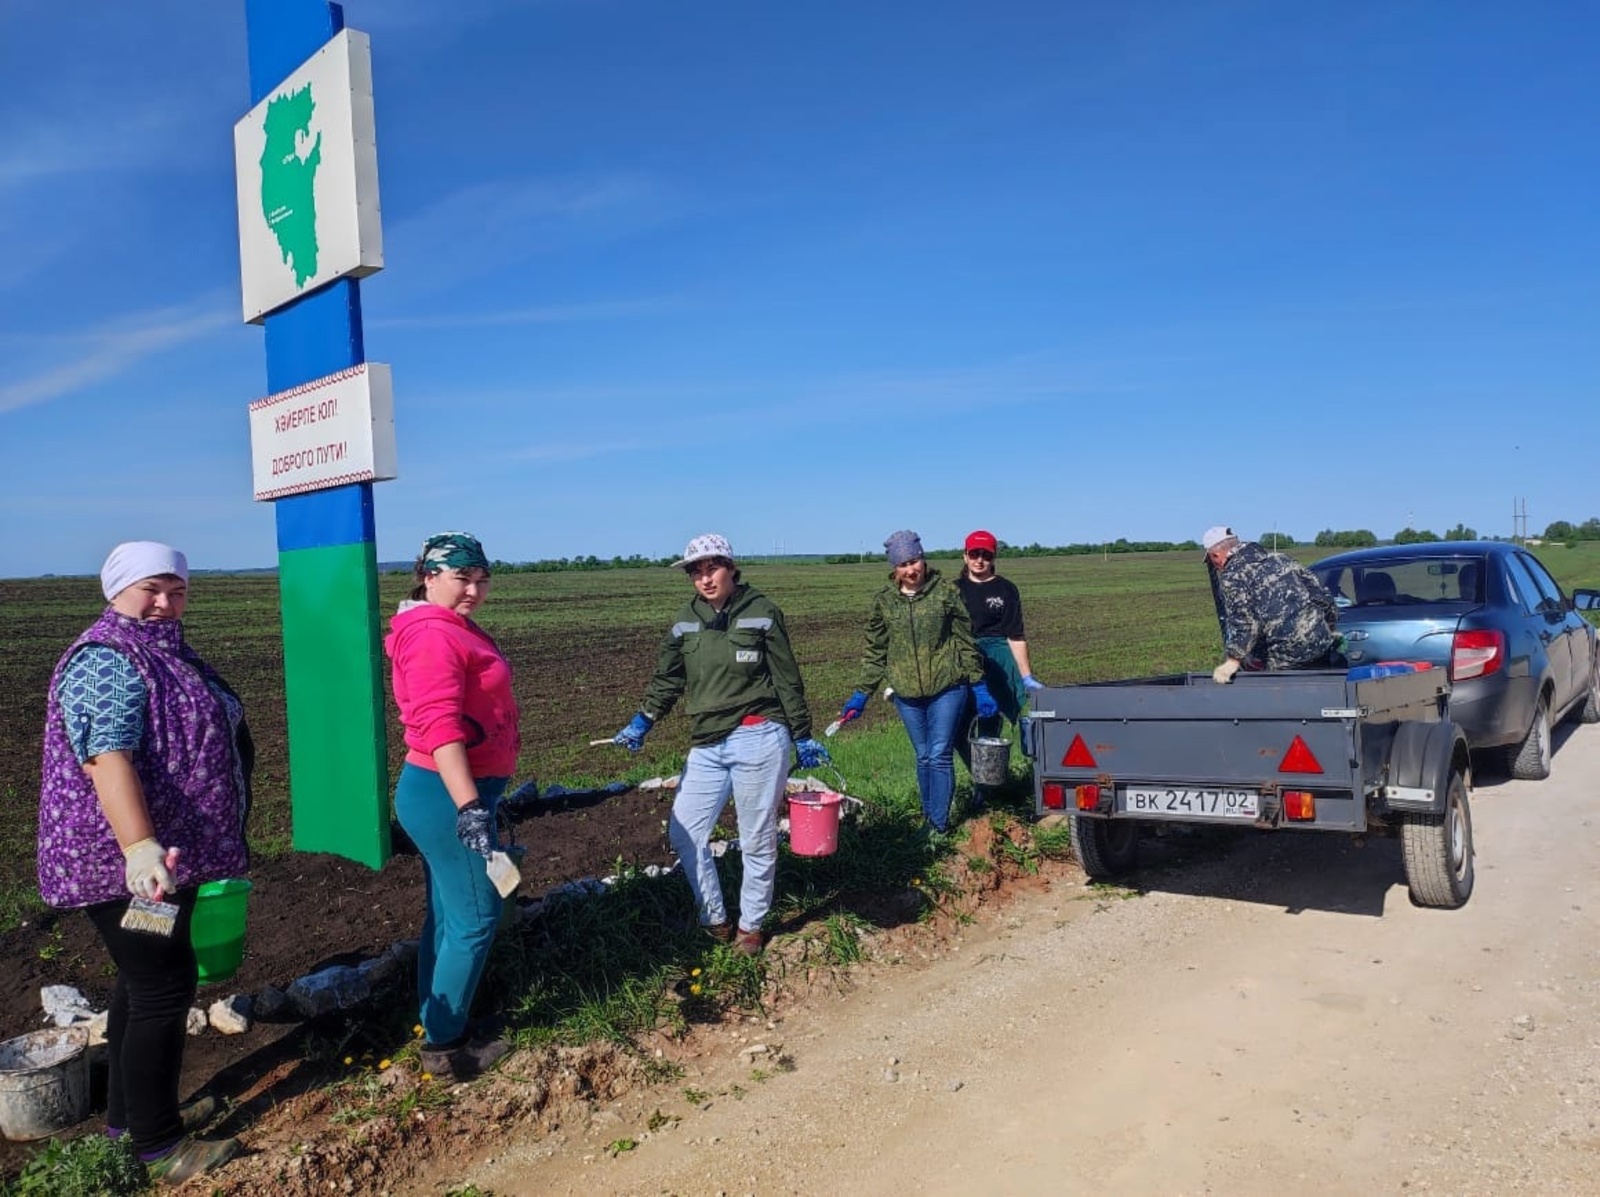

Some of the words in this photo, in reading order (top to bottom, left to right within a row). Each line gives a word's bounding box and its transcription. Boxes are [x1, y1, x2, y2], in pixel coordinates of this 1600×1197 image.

[272, 450, 314, 476] ДОБРОГО
[316, 441, 348, 464] ПУТИ!
[1165, 790, 1219, 812] 2417
[1226, 791, 1248, 808] 02
